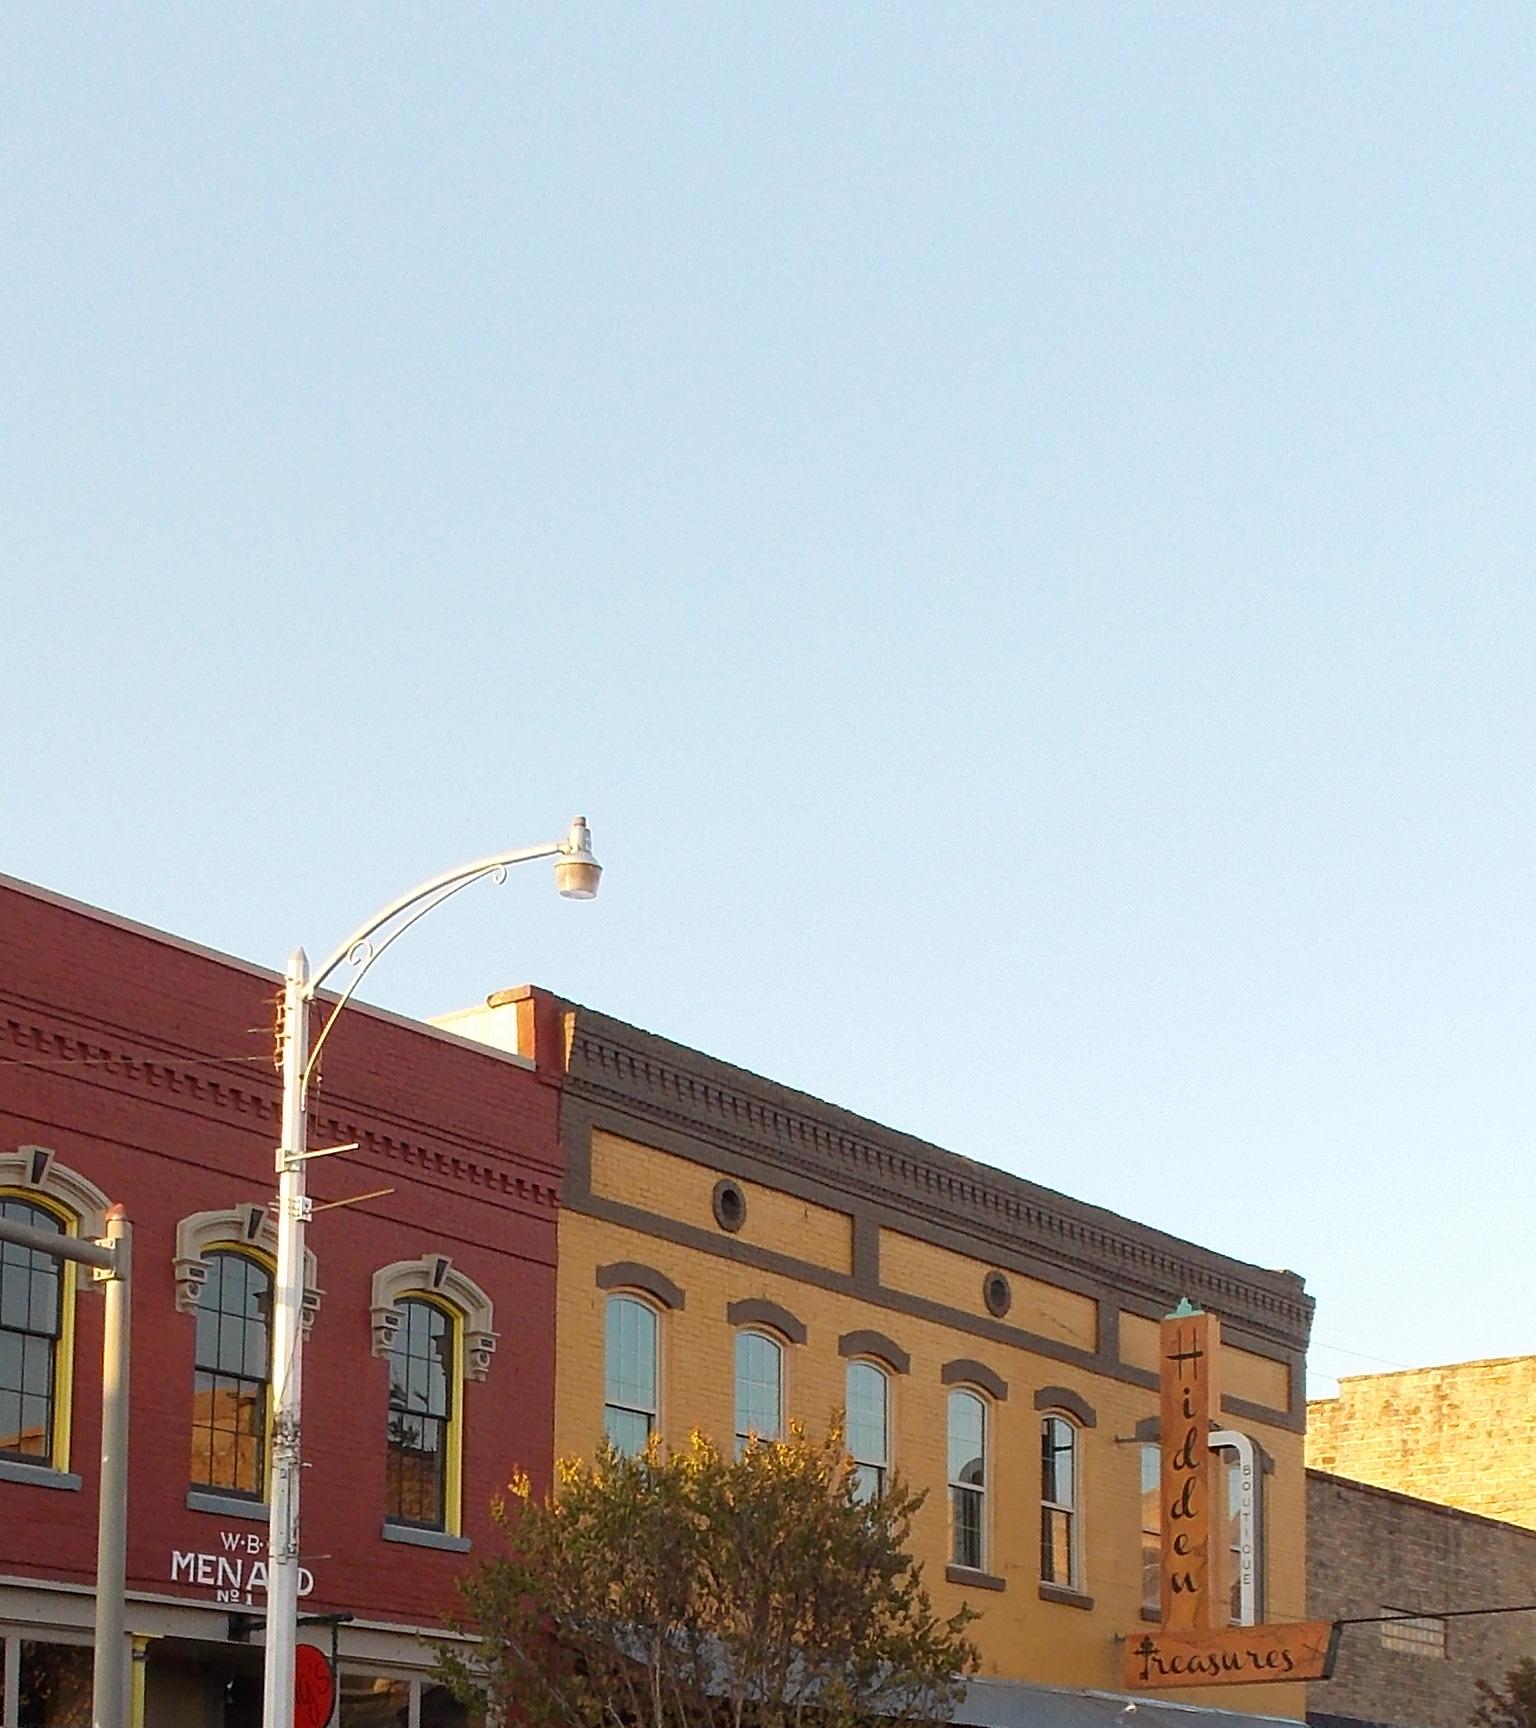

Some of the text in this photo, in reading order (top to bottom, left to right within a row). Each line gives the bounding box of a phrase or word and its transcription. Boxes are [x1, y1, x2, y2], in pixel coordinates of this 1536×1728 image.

[1164, 1326, 1204, 1595] Hidden
[170, 1550, 315, 1597] MENAD
[1242, 1464, 1252, 1586] BOUTIQUE
